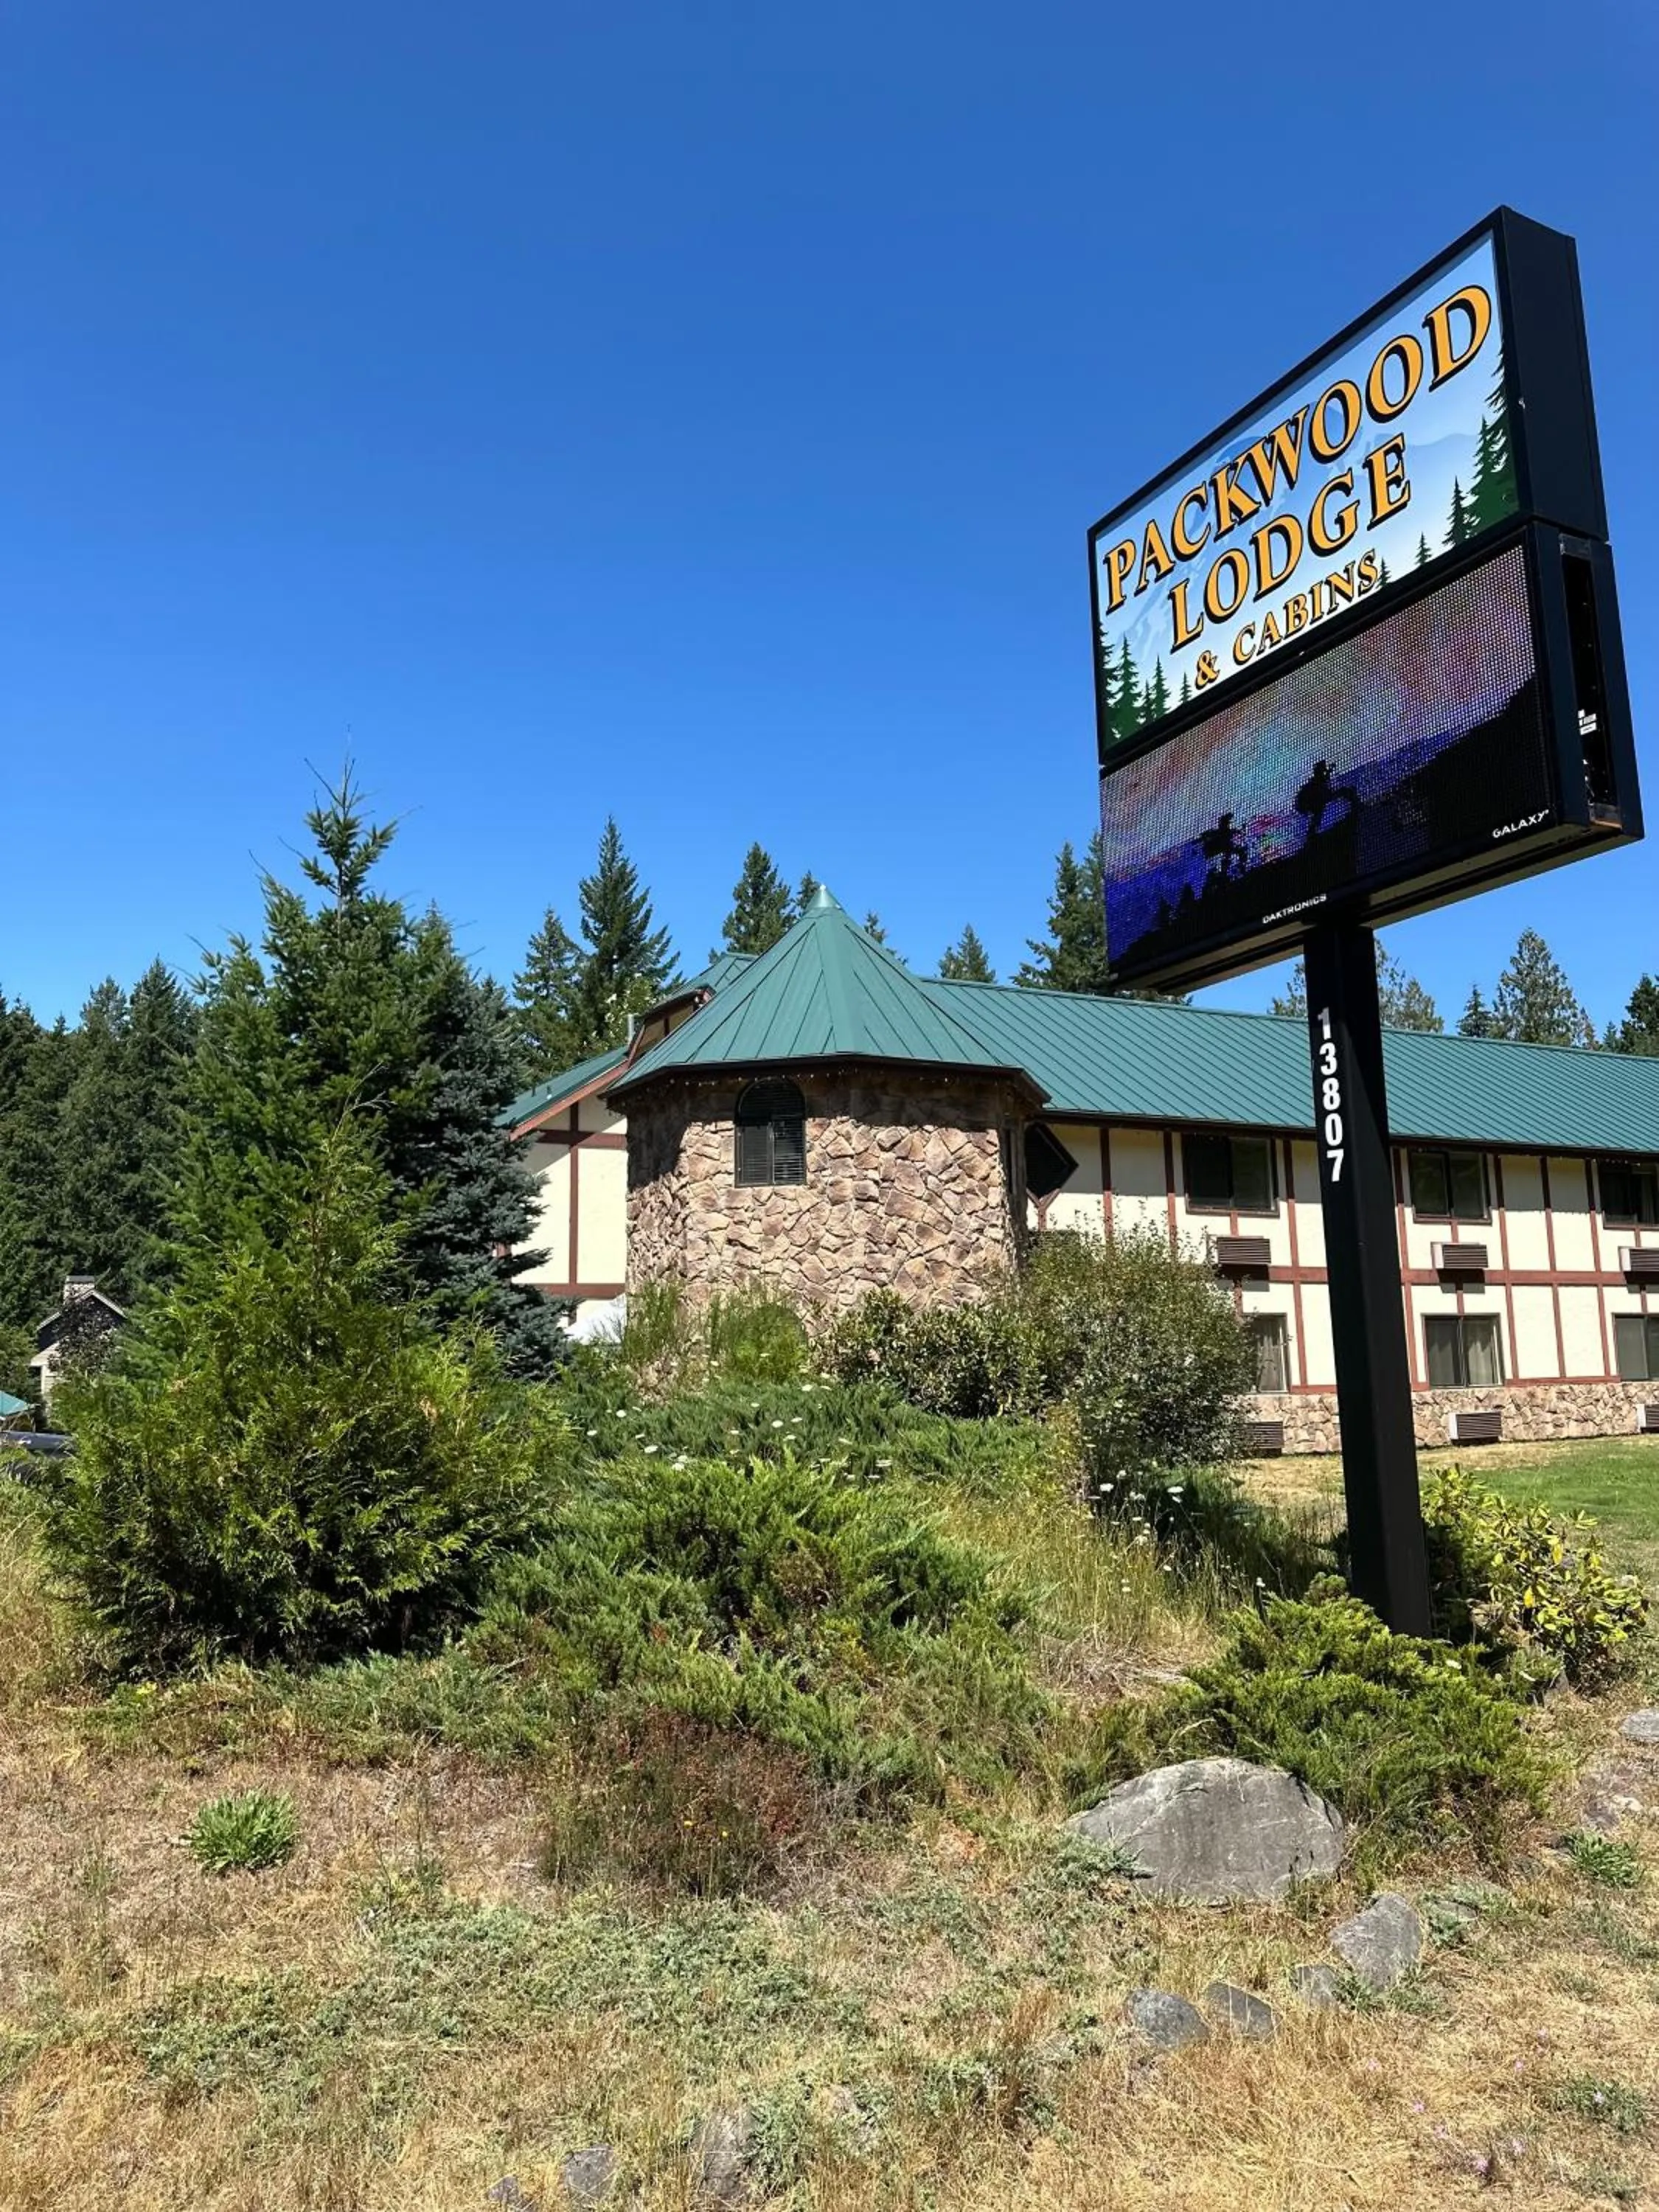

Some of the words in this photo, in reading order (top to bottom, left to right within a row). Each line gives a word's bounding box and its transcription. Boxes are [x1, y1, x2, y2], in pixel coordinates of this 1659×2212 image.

[1104, 284, 1492, 615] PACKWOOD
[1169, 432, 1411, 654] LODGE
[1194, 650, 1221, 689] &
[1233, 549, 1380, 666] CABINS
[1262, 893, 1326, 924] DAKTRONICS
[1318, 1006, 1344, 1182] 13807
